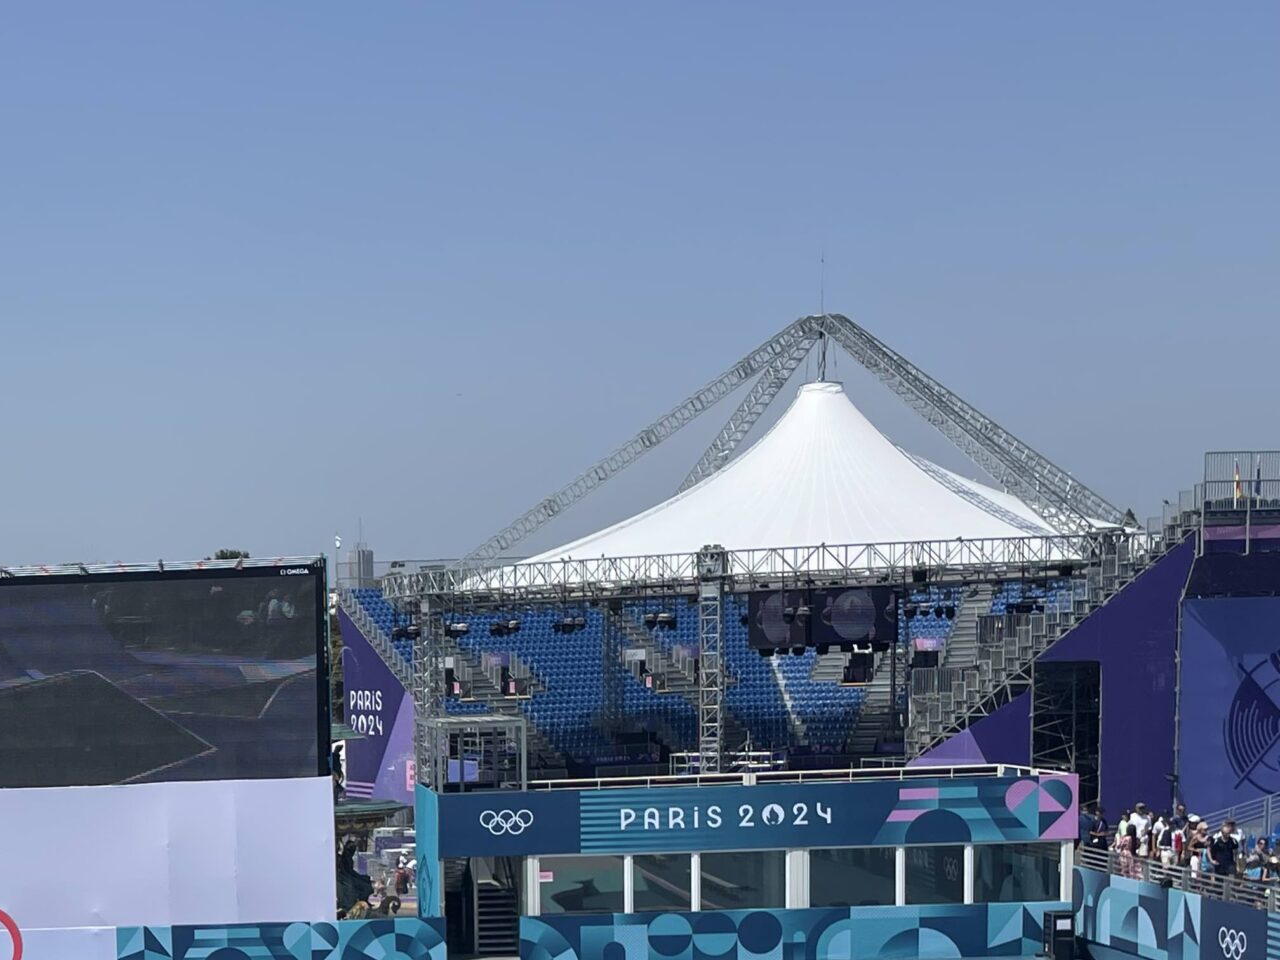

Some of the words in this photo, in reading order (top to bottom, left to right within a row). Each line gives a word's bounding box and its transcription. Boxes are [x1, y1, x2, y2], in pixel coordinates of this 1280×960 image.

[350, 690, 383, 711] PARiS
[351, 714, 383, 736] 2024
[620, 805, 722, 830] PARiS
[738, 802, 832, 828] 2024
